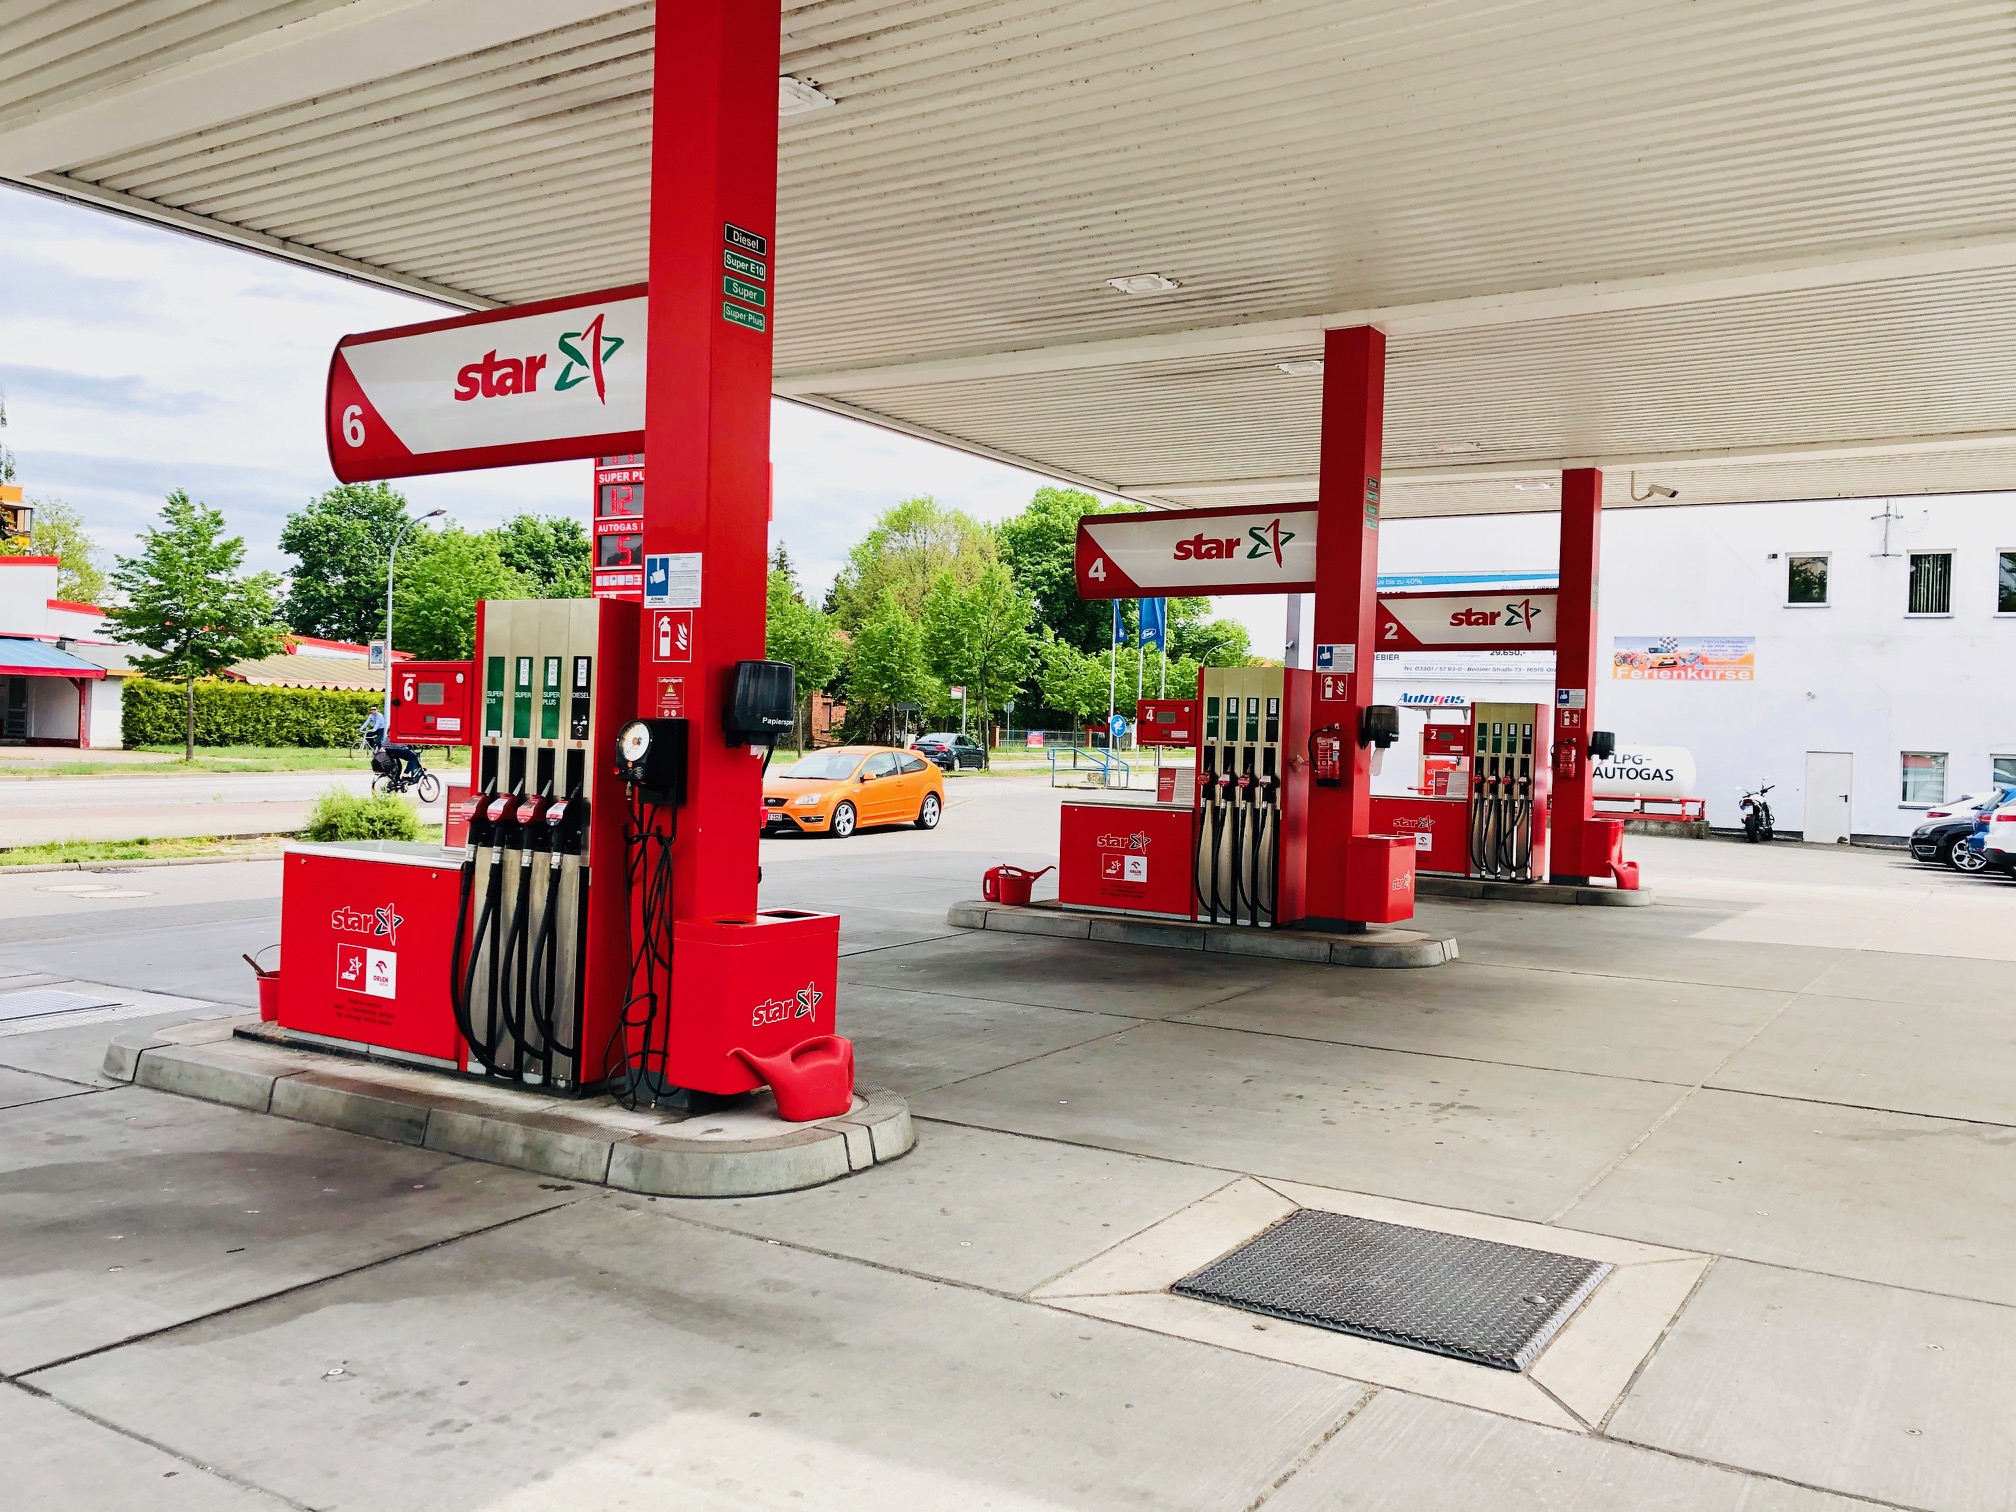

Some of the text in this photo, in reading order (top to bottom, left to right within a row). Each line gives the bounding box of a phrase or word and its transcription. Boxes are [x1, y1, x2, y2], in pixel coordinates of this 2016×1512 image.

[733, 230, 759, 250] Diesel
[726, 254, 764, 276] Super E10
[732, 282, 758, 300] Super
[725, 306, 764, 327] Super Plus
[454, 349, 547, 401] star
[342, 404, 366, 447] 6
[599, 471, 630, 484] SUPER
[597, 522, 638, 533] AUTOGAS
[1173, 532, 1241, 561] star
[1088, 557, 1107, 582] 4
[1450, 607, 1501, 627] star
[1384, 622, 1399, 640] 2
[1617, 667, 1751, 680] Ferienkurse
[403, 678, 414, 702] 6
[1398, 692, 1465, 706] Autogas
[1146, 709, 1154, 722] 4
[1431, 730, 1437, 740] 2
[1592, 766, 1674, 781] AUTOGAS
[1393, 816, 1418, 827] star
[1097, 833, 1129, 849] star
[331, 905, 373, 933] star
[341, 971, 357, 981] star
[752, 998, 793, 1026] star
